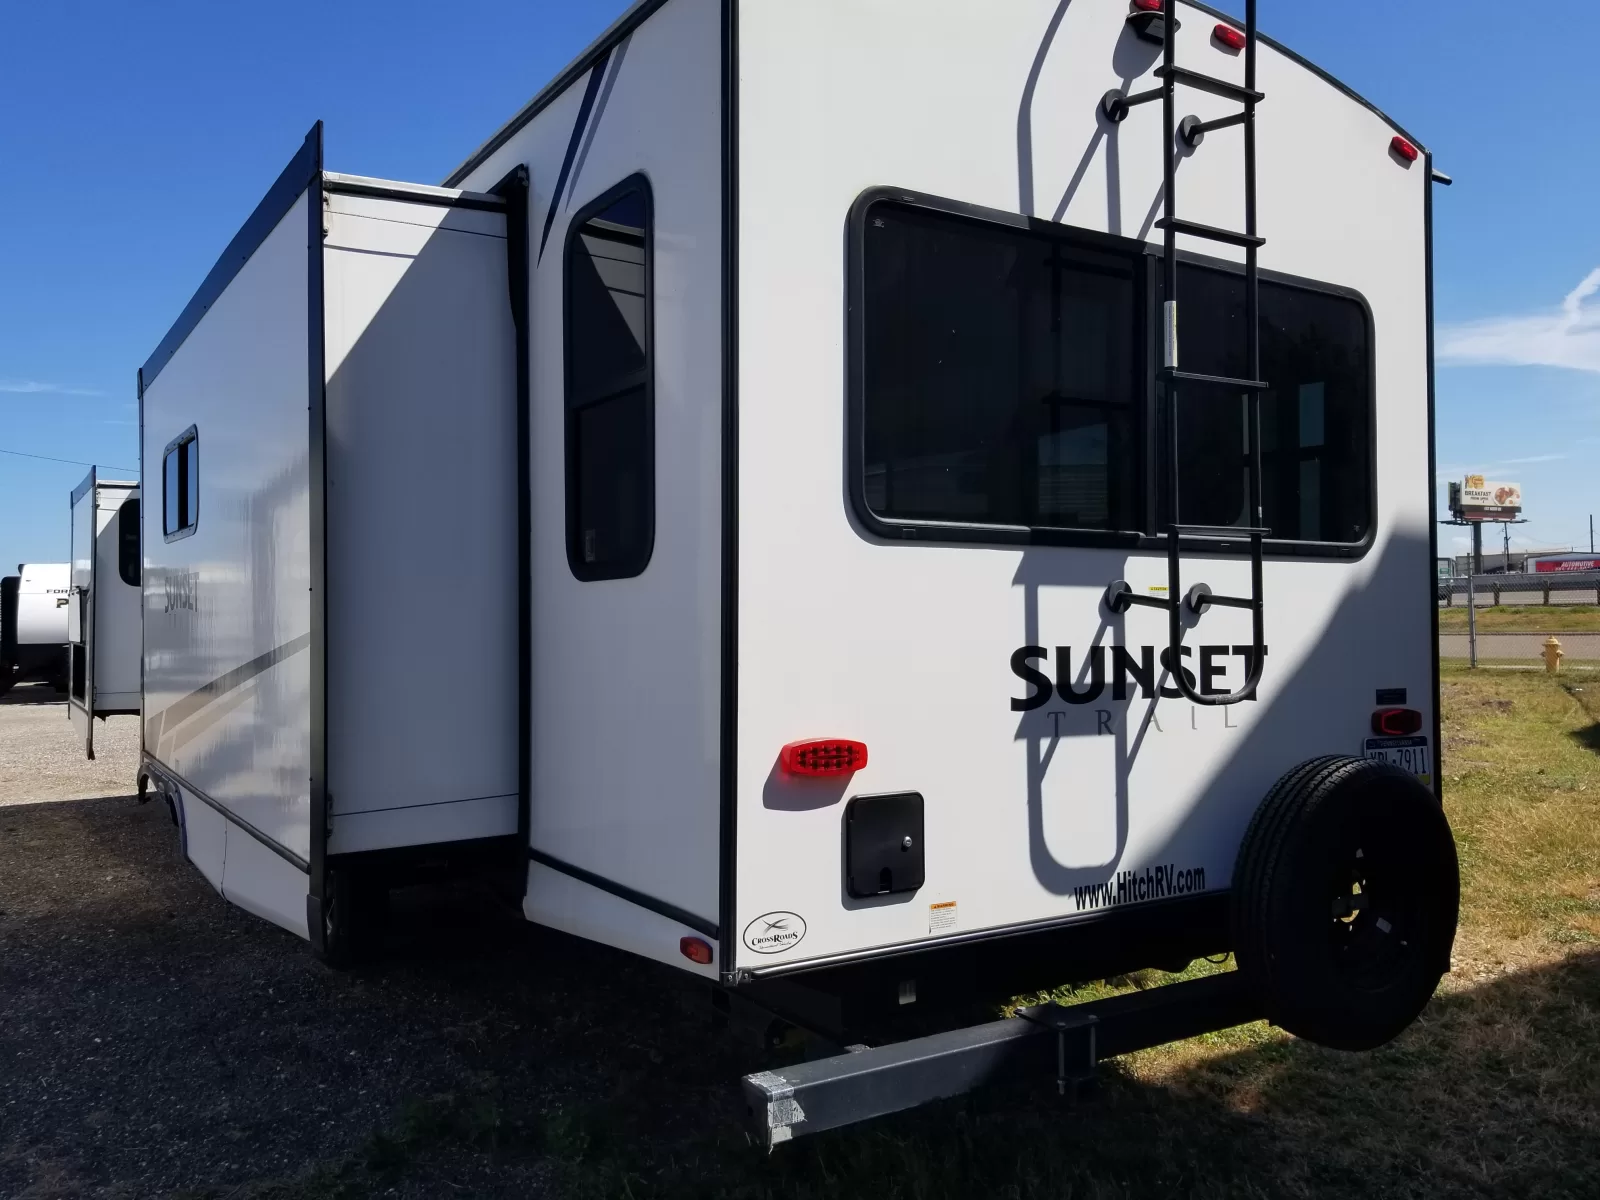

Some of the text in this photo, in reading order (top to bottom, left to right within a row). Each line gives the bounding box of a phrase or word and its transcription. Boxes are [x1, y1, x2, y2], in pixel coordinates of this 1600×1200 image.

[1560, 560, 1595, 568] AUTOMOTIVE
[164, 572, 200, 613] SUNSET
[1010, 645, 1268, 712] SUNSET
[1046, 705, 1238, 738] TRAIL
[1074, 863, 1206, 911] www.HitchRV.com
